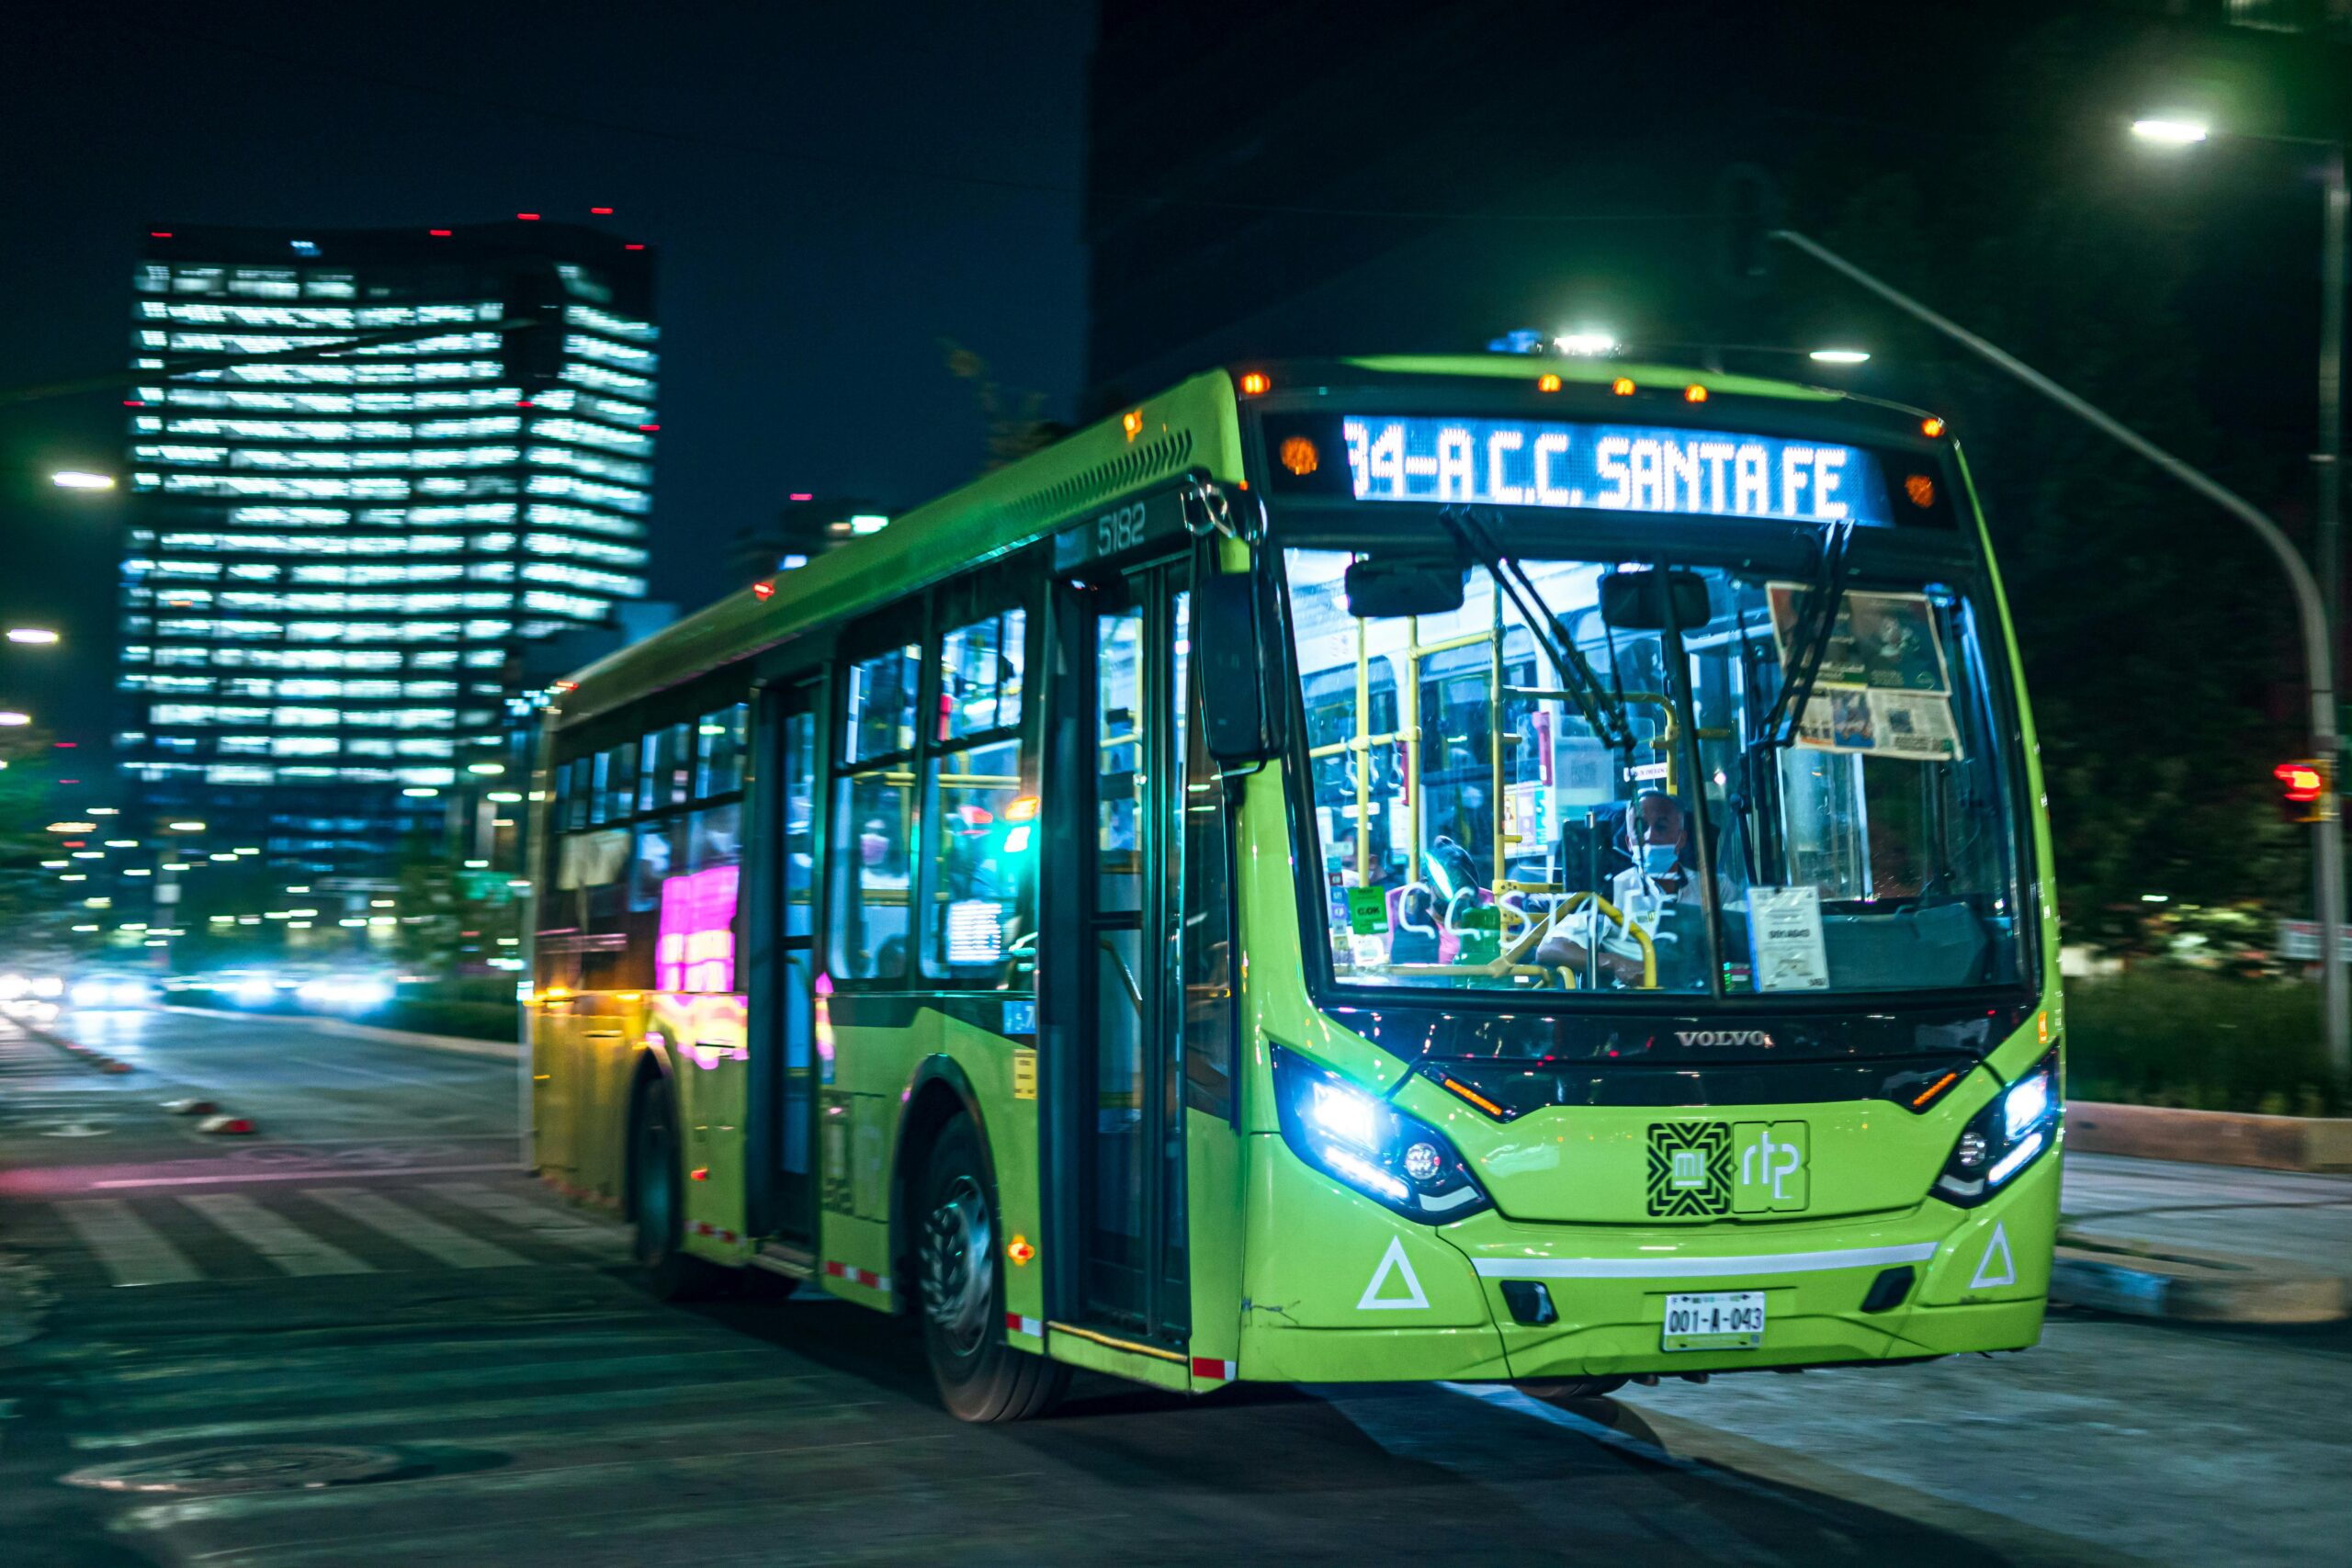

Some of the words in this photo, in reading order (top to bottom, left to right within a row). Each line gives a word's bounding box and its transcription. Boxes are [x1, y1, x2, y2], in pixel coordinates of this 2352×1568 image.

[1488, 431, 1582, 506] C.C.
[1597, 436, 1768, 515] SANTA
[1782, 446, 1847, 519] FE
[1097, 501, 1147, 558] 5182
[1674, 1030, 1766, 1047] VOLVO
[1668, 1307, 1763, 1334] 001-A-043
